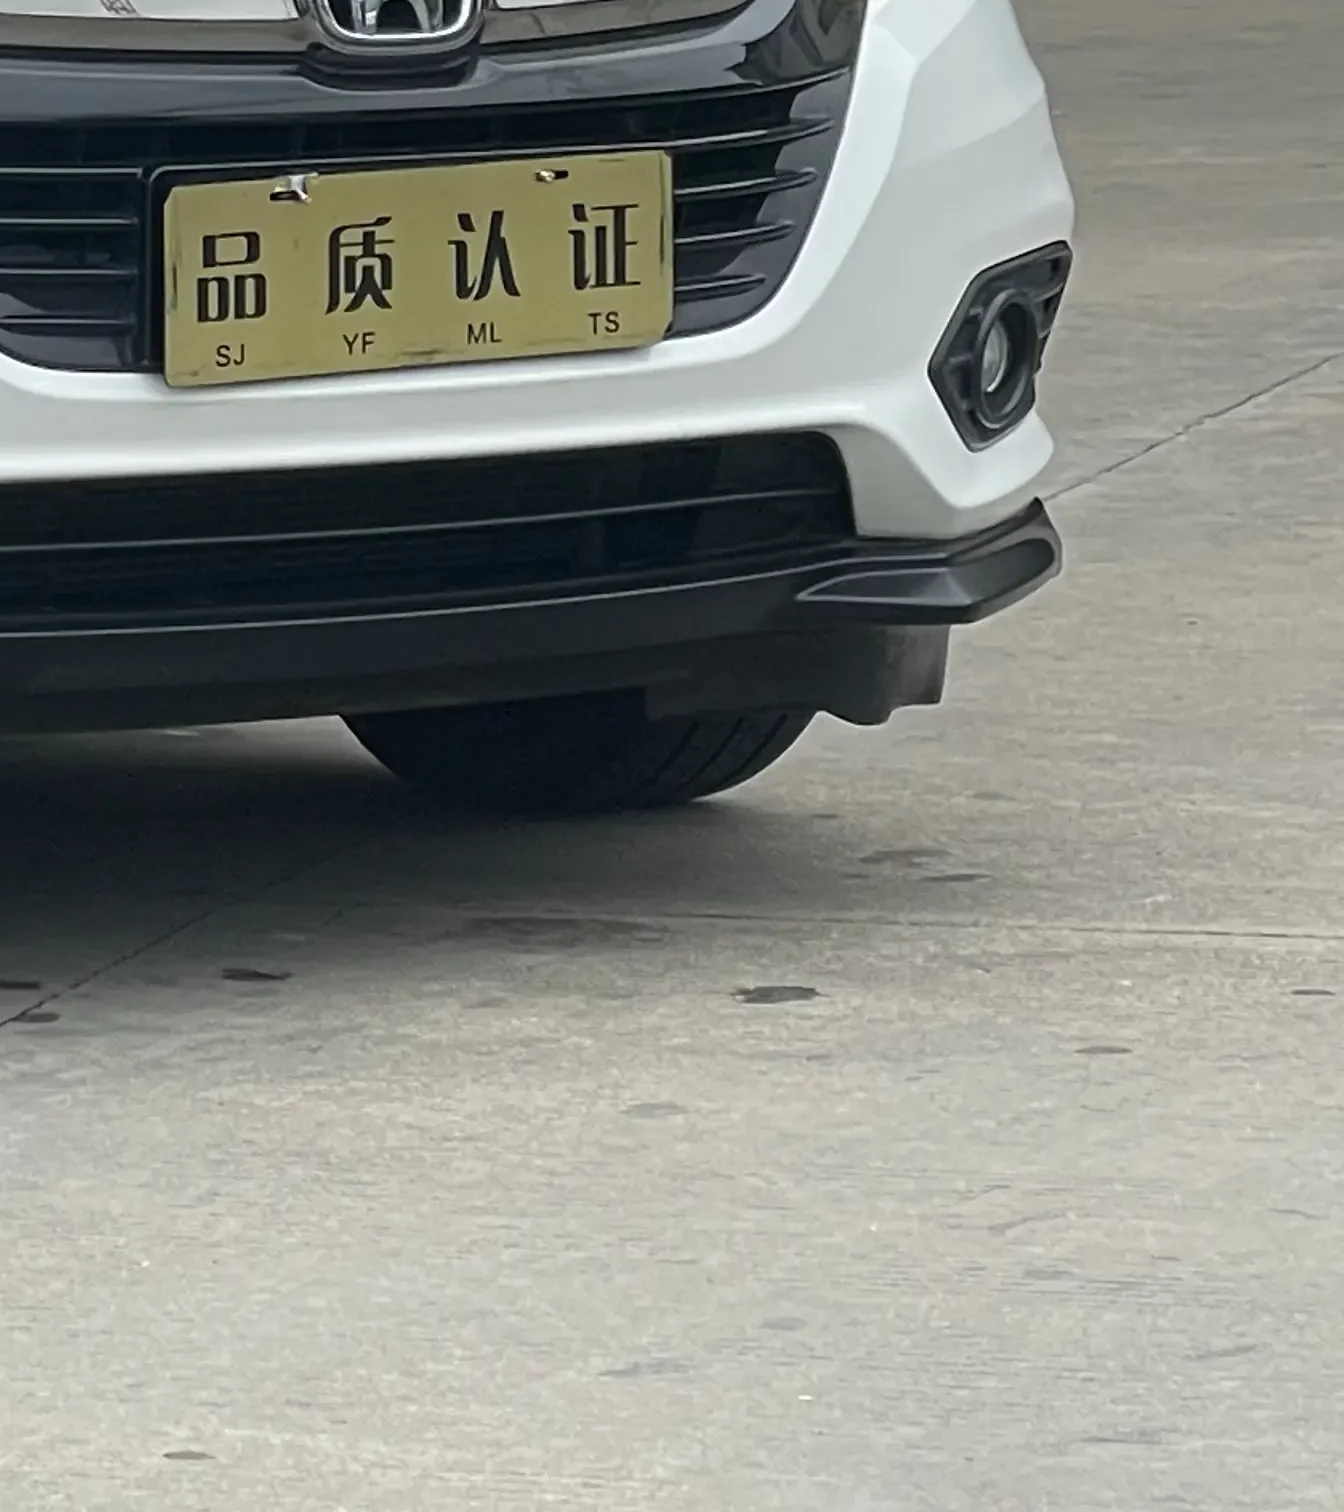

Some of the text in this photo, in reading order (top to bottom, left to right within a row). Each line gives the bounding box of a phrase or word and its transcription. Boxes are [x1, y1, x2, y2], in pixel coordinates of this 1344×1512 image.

[196, 202, 641, 324] 品质认证
[215, 310, 621, 367] SJ YF ML TS
